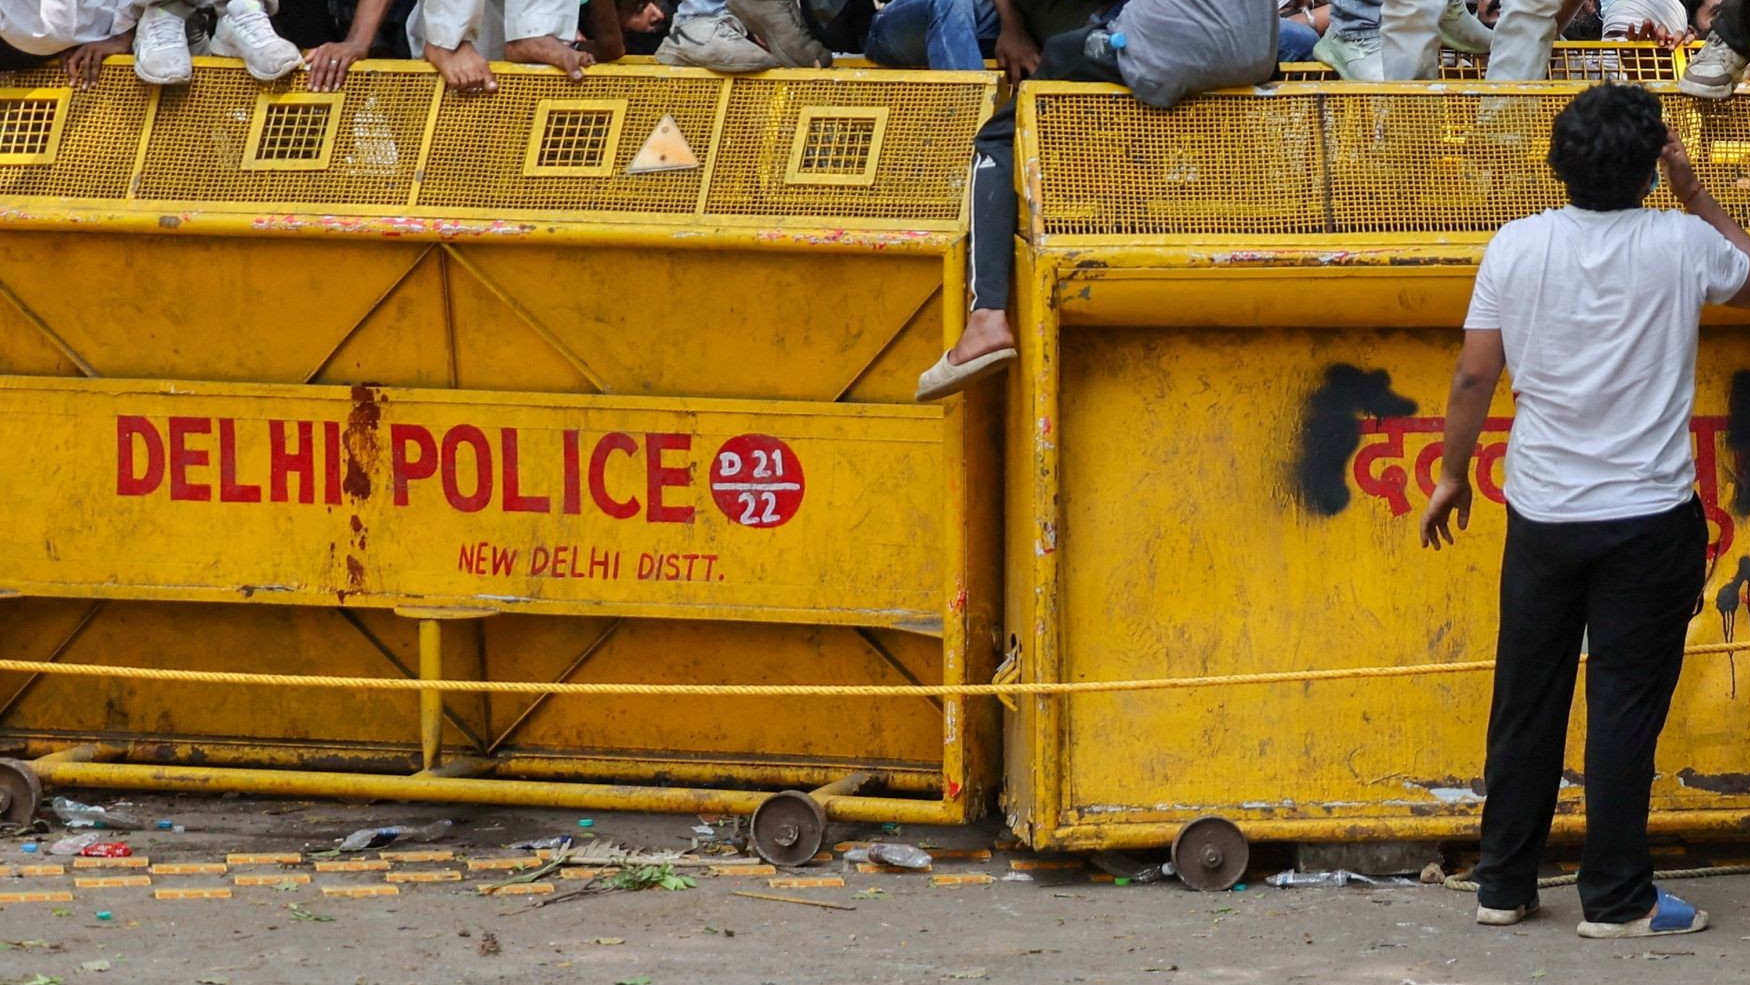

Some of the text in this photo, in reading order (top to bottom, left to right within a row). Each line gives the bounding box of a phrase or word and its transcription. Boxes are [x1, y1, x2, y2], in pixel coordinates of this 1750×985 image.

[117, 414, 696, 524] DELHI POLICE
[719, 448, 784, 478] D 21
[738, 491, 781, 525] 22
[458, 542, 725, 582] NEW DELHI DISTT.
